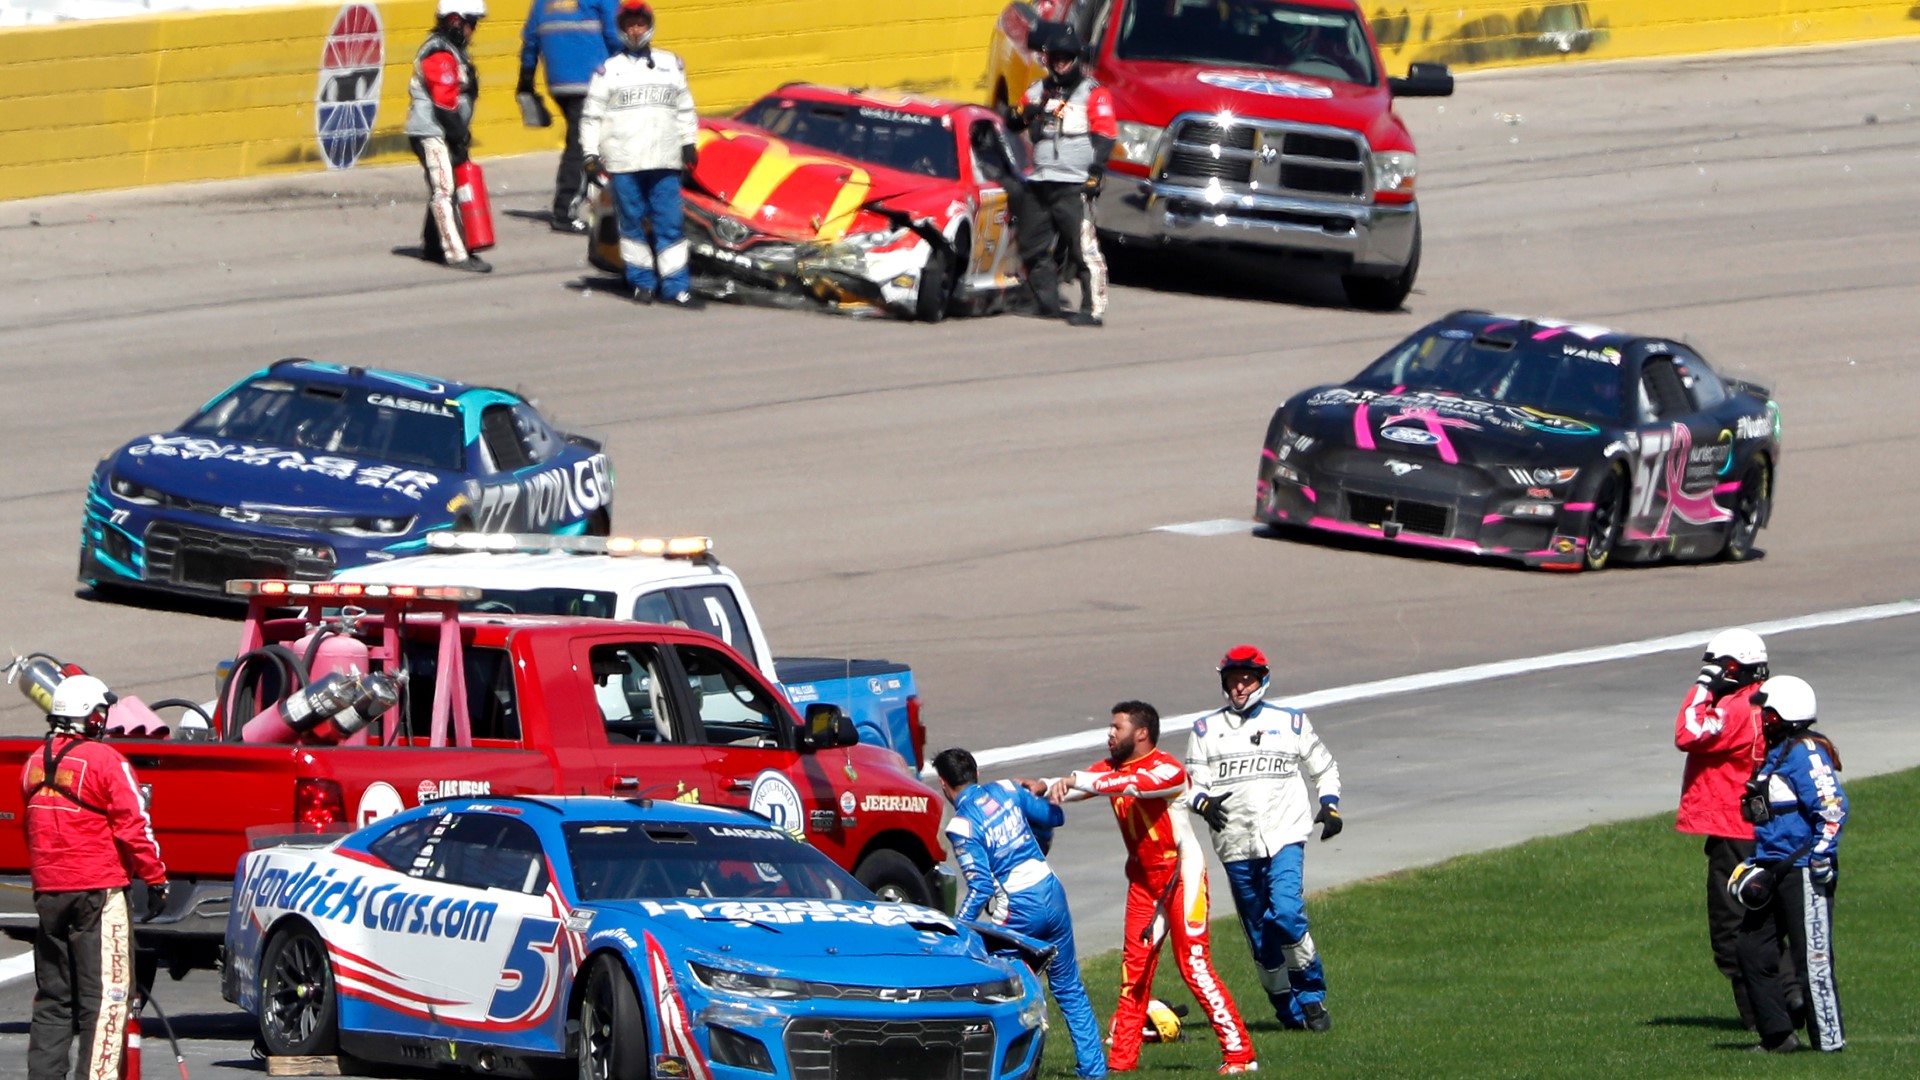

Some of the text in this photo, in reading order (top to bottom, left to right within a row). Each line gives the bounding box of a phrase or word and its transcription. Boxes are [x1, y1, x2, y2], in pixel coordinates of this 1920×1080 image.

[367, 393, 455, 417] CASSILL
[110, 509, 130, 525] 77
[478, 483, 520, 533] 77
[439, 780, 491, 797] LAS VEGAS
[860, 795, 929, 813] JERR-DAN
[709, 827, 785, 841] LARSON
[237, 853, 499, 943] HendrickCars.com
[111, 924, 123, 984] FIRE
[487, 915, 561, 1021] 5
